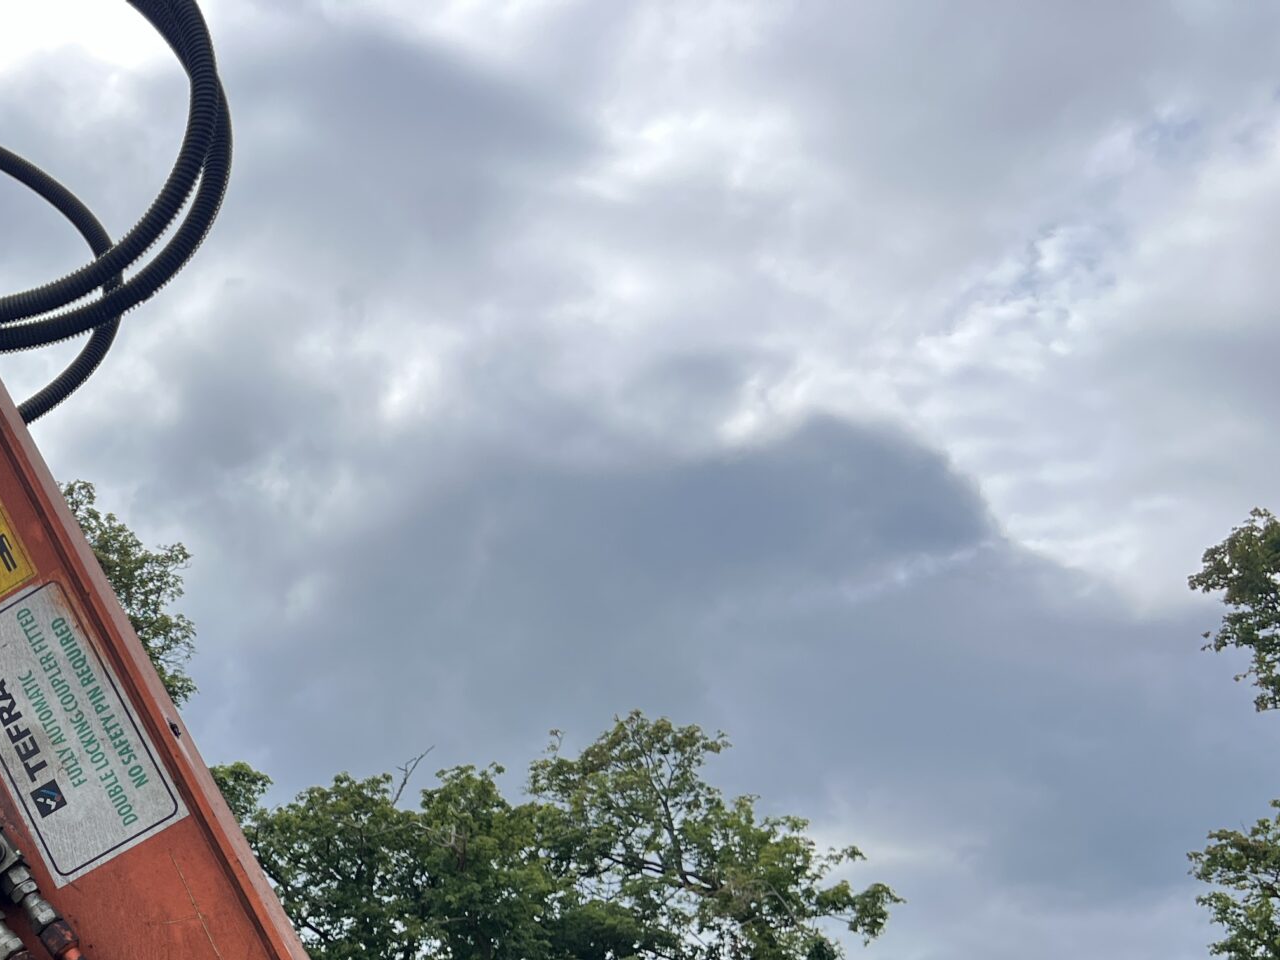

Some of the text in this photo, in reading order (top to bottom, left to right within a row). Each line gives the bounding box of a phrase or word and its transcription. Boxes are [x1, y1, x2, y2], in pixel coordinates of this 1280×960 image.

[16, 607, 138, 826] DOUBLE LOCKING COUPLER FITTED
[17, 669, 87, 787] FULLY AUTOMATIC
[51, 617, 149, 789] NO SAFETY PIN REQUIRED
